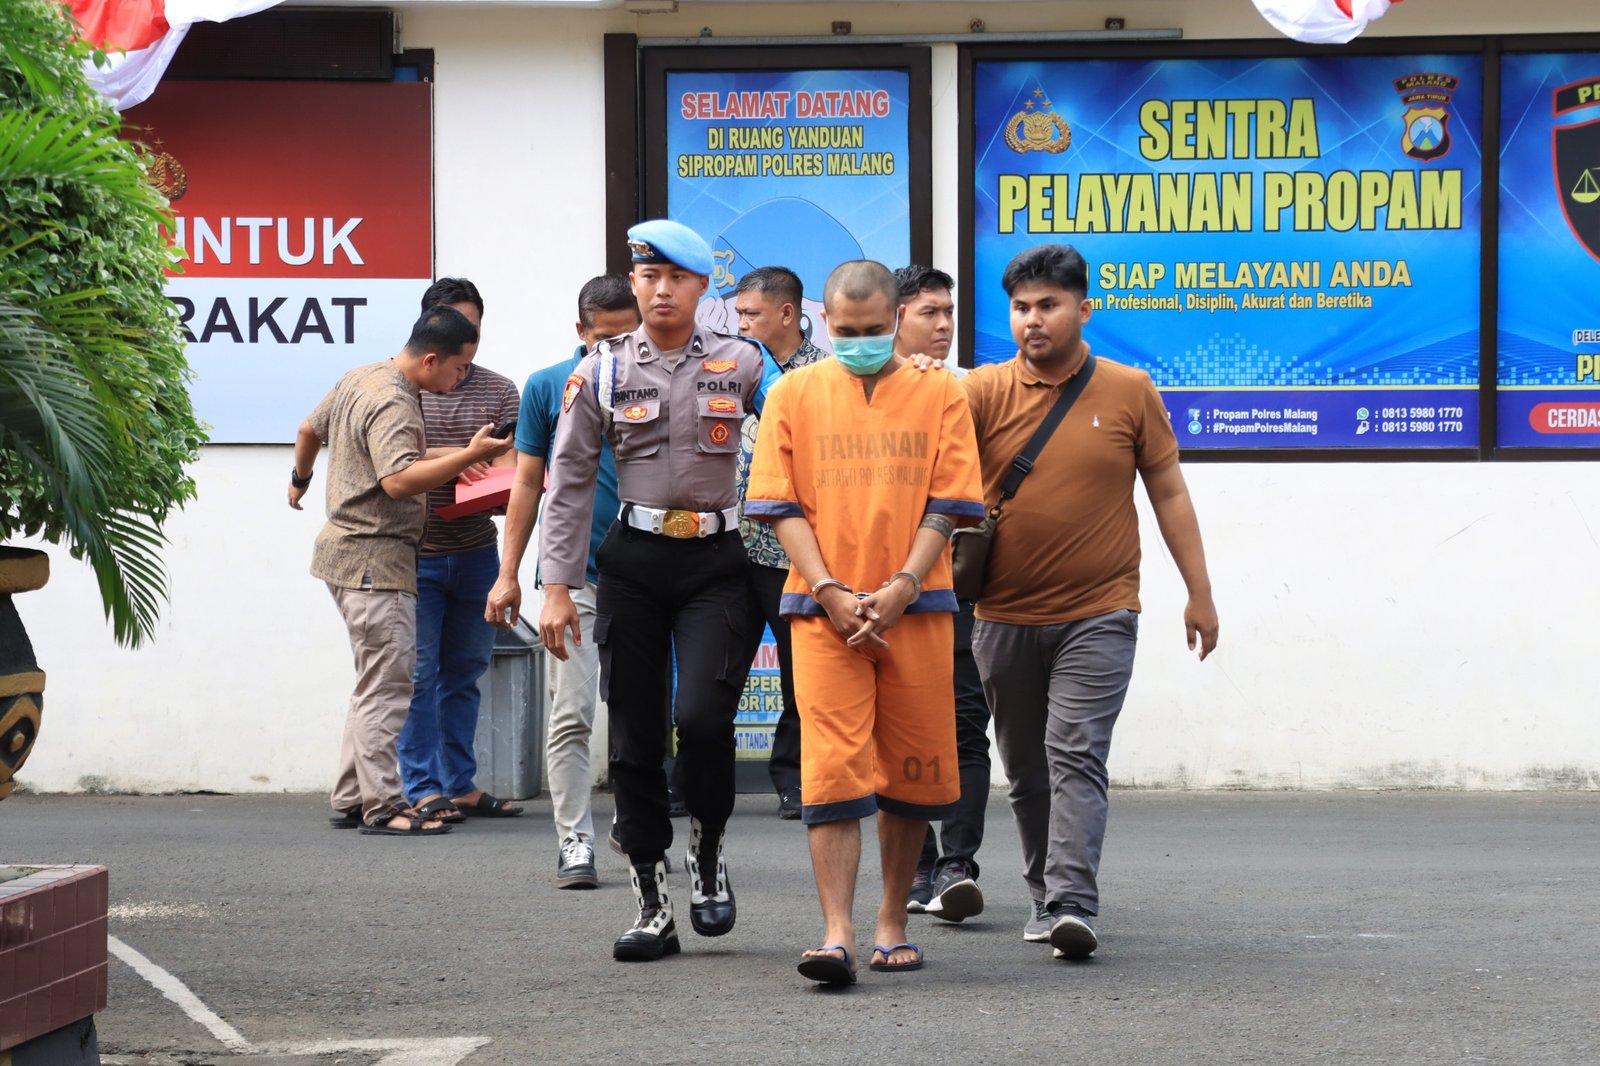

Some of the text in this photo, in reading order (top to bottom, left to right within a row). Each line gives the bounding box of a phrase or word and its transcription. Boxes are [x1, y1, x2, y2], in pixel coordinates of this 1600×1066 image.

[681, 90, 889, 119] SELAMAT DATANG
[707, 125, 863, 150] DI RUANG YANDUAN
[1139, 98, 1320, 160] SENTRA
[677, 152, 894, 177] SIPROPAM POLRES MALANG
[998, 168, 1462, 234] PELAYANAN PROPAM
[1099, 262, 1166, 290] SIAP
[1175, 261, 1321, 289] MELAYANI
[1329, 260, 1413, 288] ANDA
[1106, 293, 1183, 313] Profesional,
[1186, 293, 1239, 313] Disiplin,
[1241, 292, 1286, 309] Akurat
[1288, 293, 1313, 309] dan
[1316, 292, 1373, 309] Beretika
[615, 387, 659, 401] BINTANG
[697, 381, 742, 393] POLRI
[1213, 409, 1249, 421] Propam
[1251, 409, 1281, 419] Polres
[1283, 409, 1318, 421] Malang
[1382, 407, 1407, 418] 0813
[1409, 407, 1435, 418] 5980
[1437, 407, 1463, 418] 1770
[1213, 422, 1318, 435] #PropamPolresMalang
[1382, 421, 1407, 432] 0813
[1409, 421, 1435, 432] 5980
[1437, 421, 1463, 432] 1770
[815, 431, 928, 461] TAHANAN
[860, 465, 895, 488] POLRES
[745, 732, 769, 750] TANDA
[903, 755, 941, 783] 01
